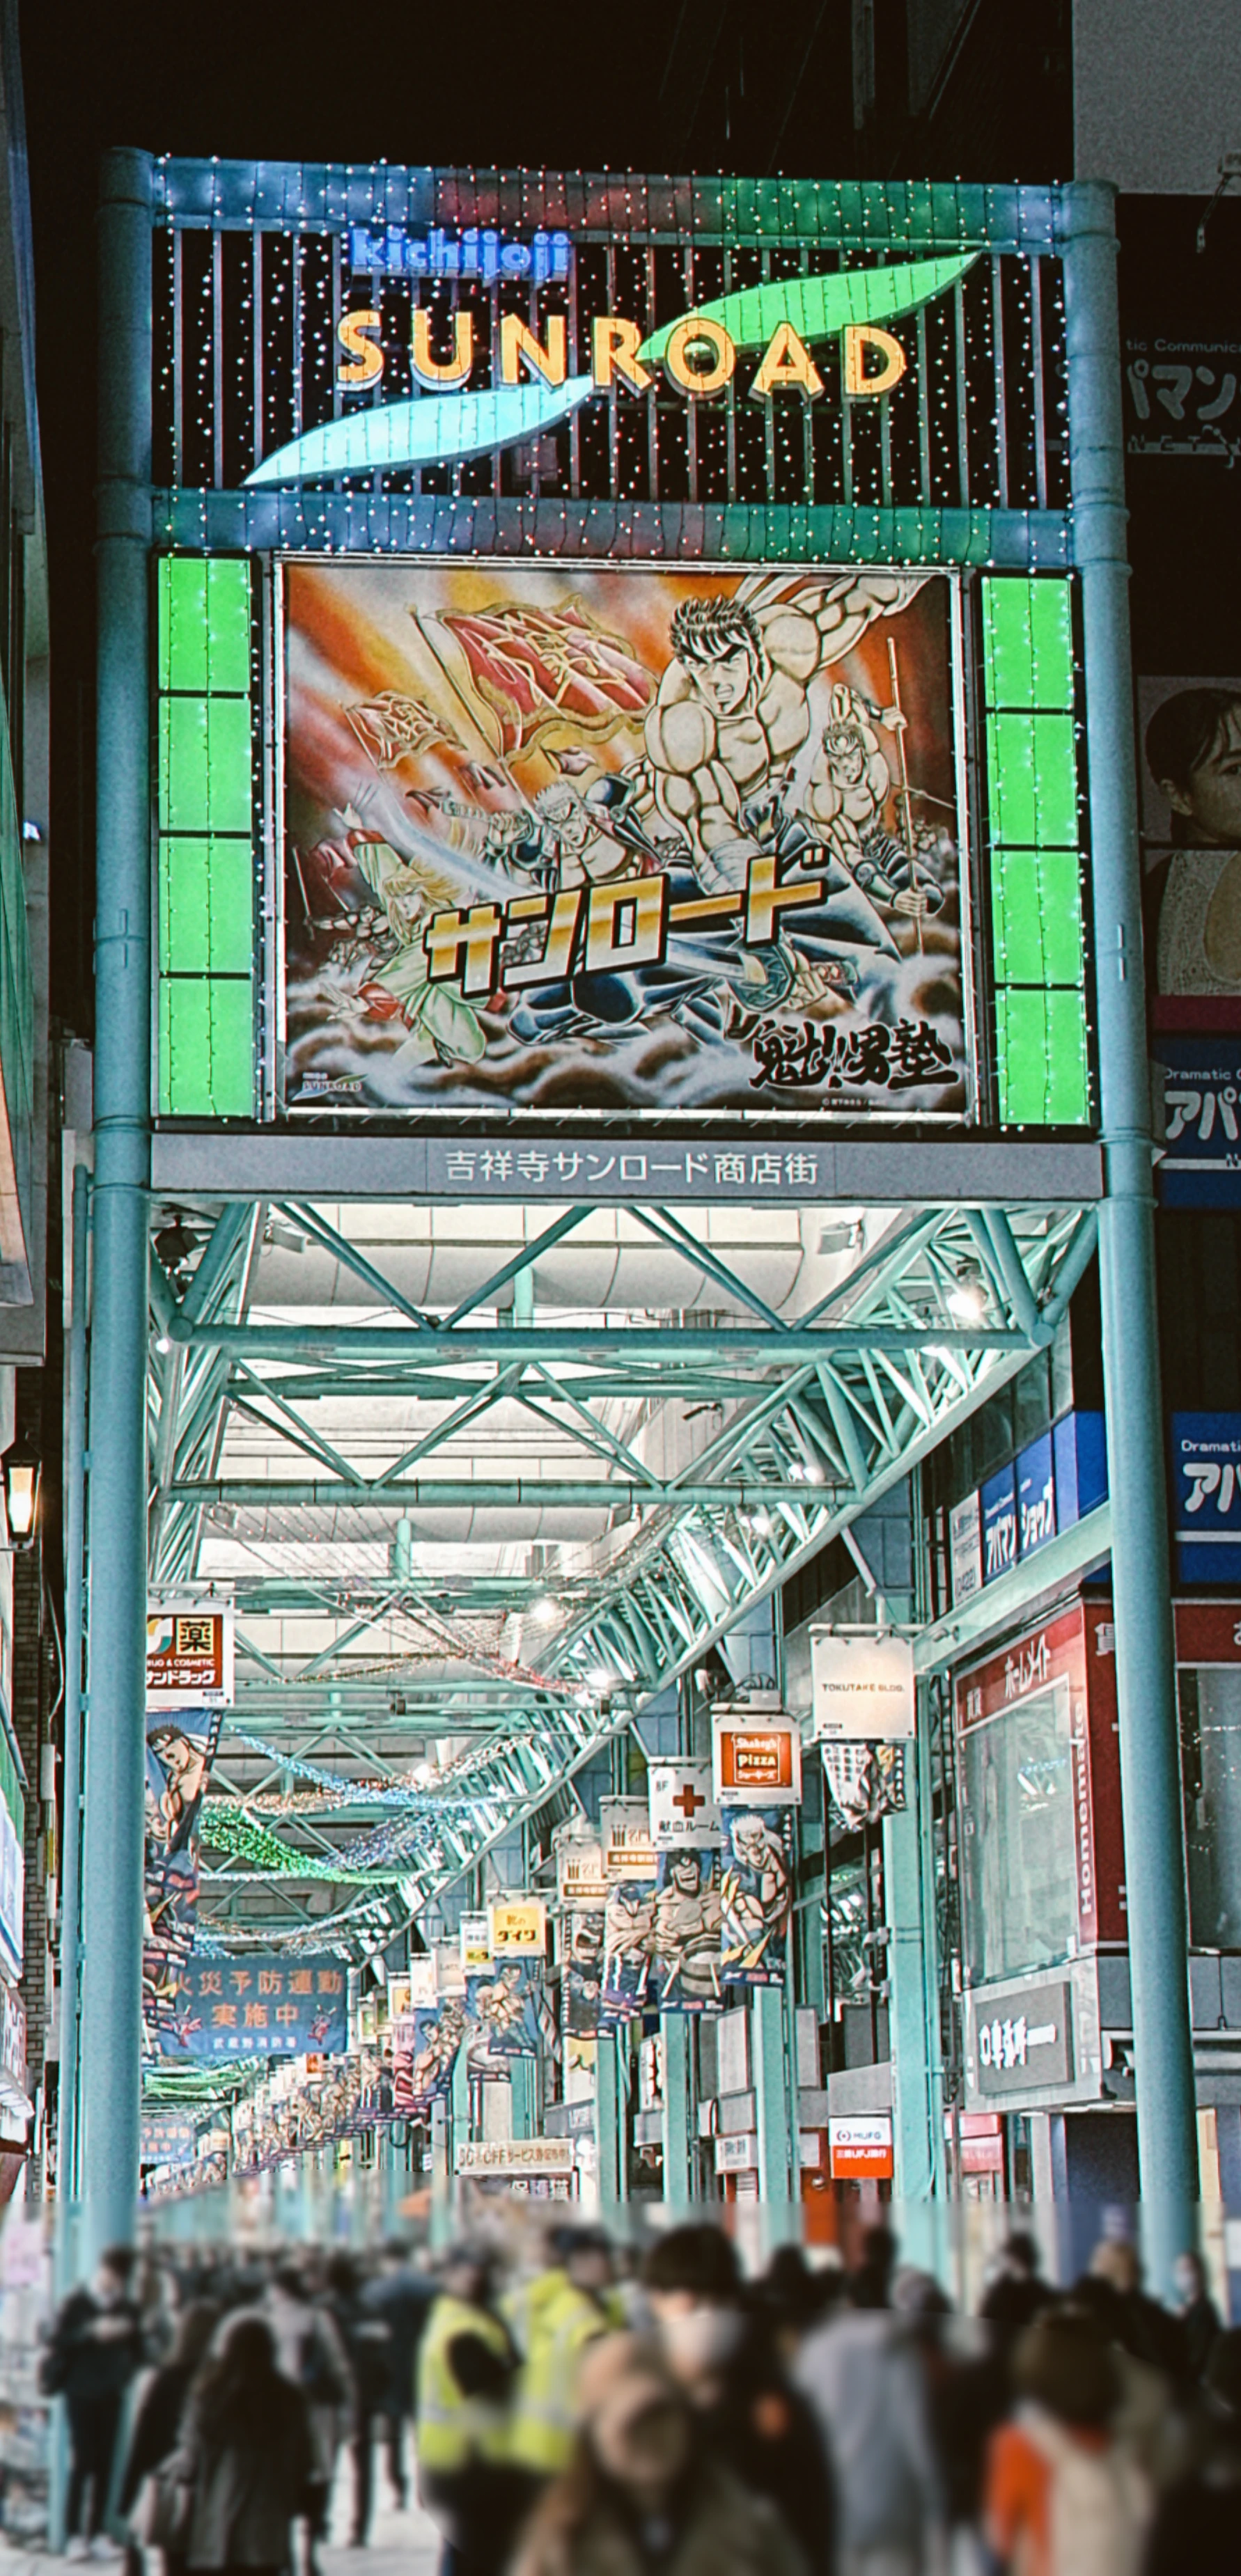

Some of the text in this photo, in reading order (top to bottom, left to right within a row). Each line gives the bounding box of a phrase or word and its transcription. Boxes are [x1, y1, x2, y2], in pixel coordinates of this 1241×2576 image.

[351, 228, 570, 286] kichijoji
[337, 310, 905, 399] SUNROAD
[1155, 338, 1241, 353] Communic
[423, 845, 829, 998] サンロード
[1164, 1086, 1241, 1140] アパ
[446, 1150, 819, 1184] 吉祥寺サンロード商店街
[180, 1621, 212, 1652] 薬
[174, 1658, 215, 1667] COSMETIC
[822, 1683, 875, 1692] TOKUTAKE
[177, 1970, 343, 1997] 火災予防運動
[212, 2002, 299, 2029] 実施中
